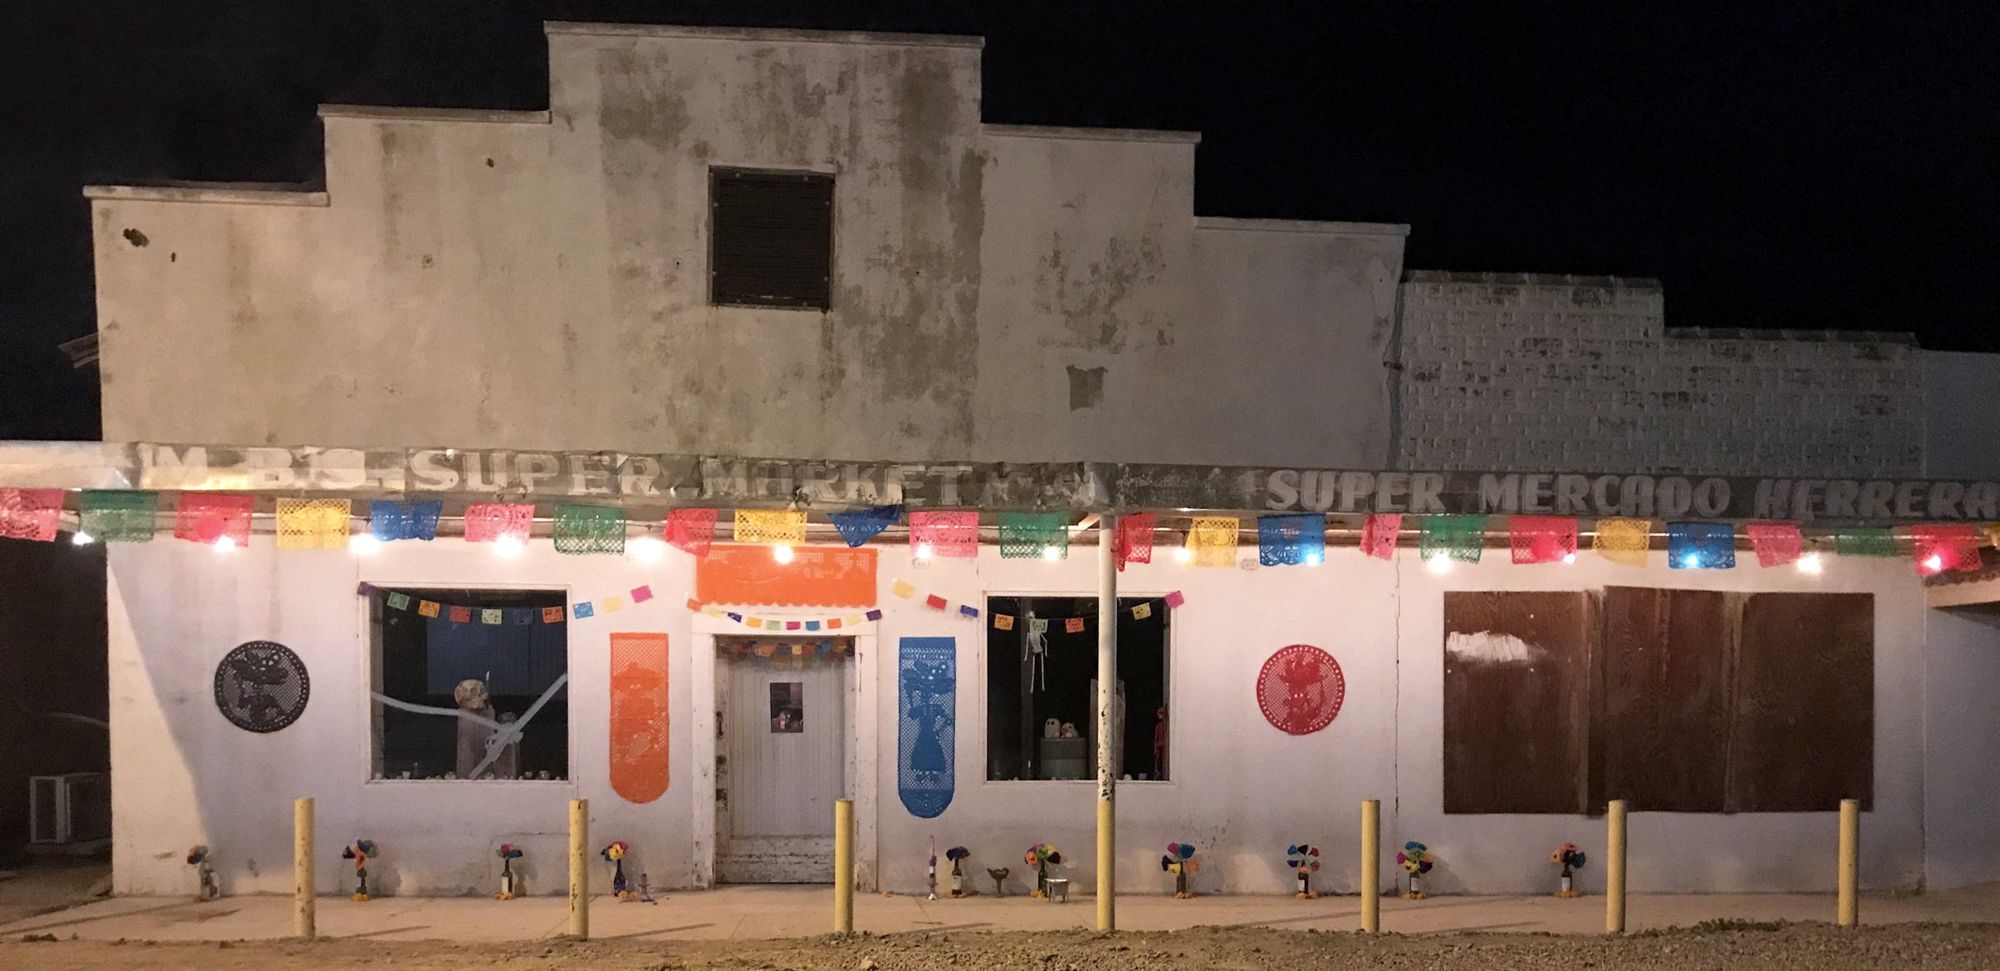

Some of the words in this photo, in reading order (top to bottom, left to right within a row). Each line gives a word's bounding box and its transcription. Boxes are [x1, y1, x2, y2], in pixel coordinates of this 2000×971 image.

[409, 449, 661, 496] SUPER
[699, 457, 973, 508] MARKET
[1265, 469, 1447, 513] SUPER
[1478, 473, 1731, 517] MERCADO
[1753, 478, 2000, 521] HERRERA
